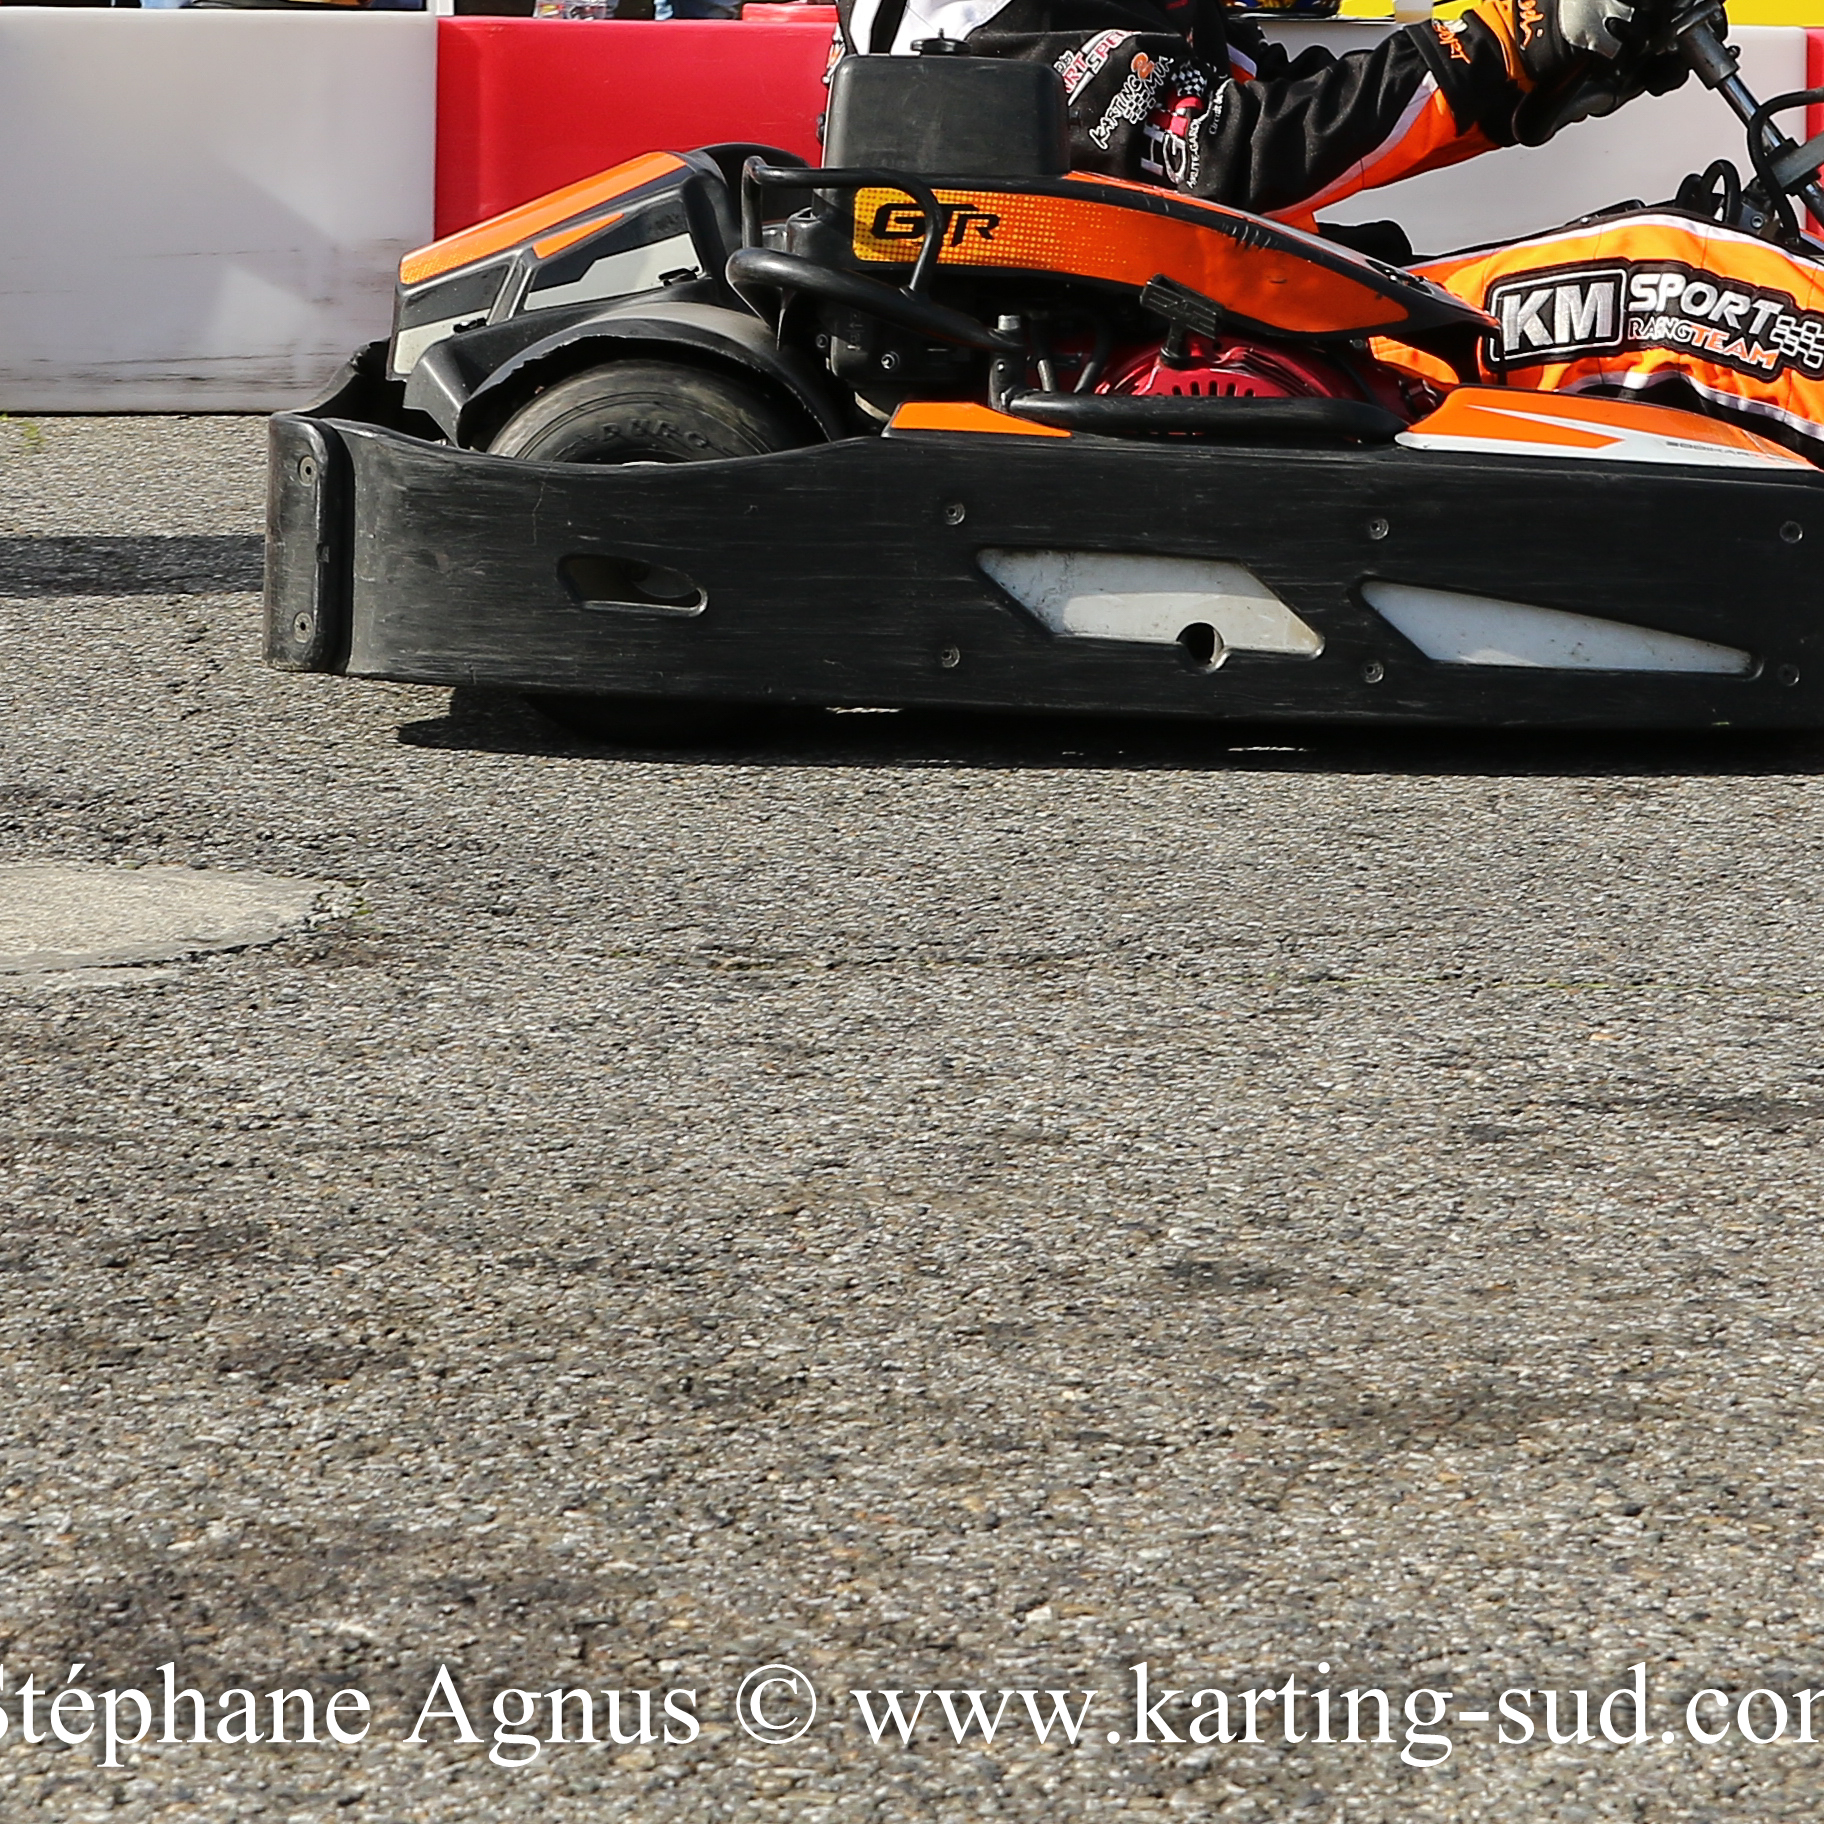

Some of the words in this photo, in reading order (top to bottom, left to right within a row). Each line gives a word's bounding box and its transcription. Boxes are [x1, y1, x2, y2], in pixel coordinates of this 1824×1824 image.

[1089, 74, 1144, 150] KARTING
[1501, 281, 1616, 351] KM
[1627, 272, 1784, 336] SPORT
